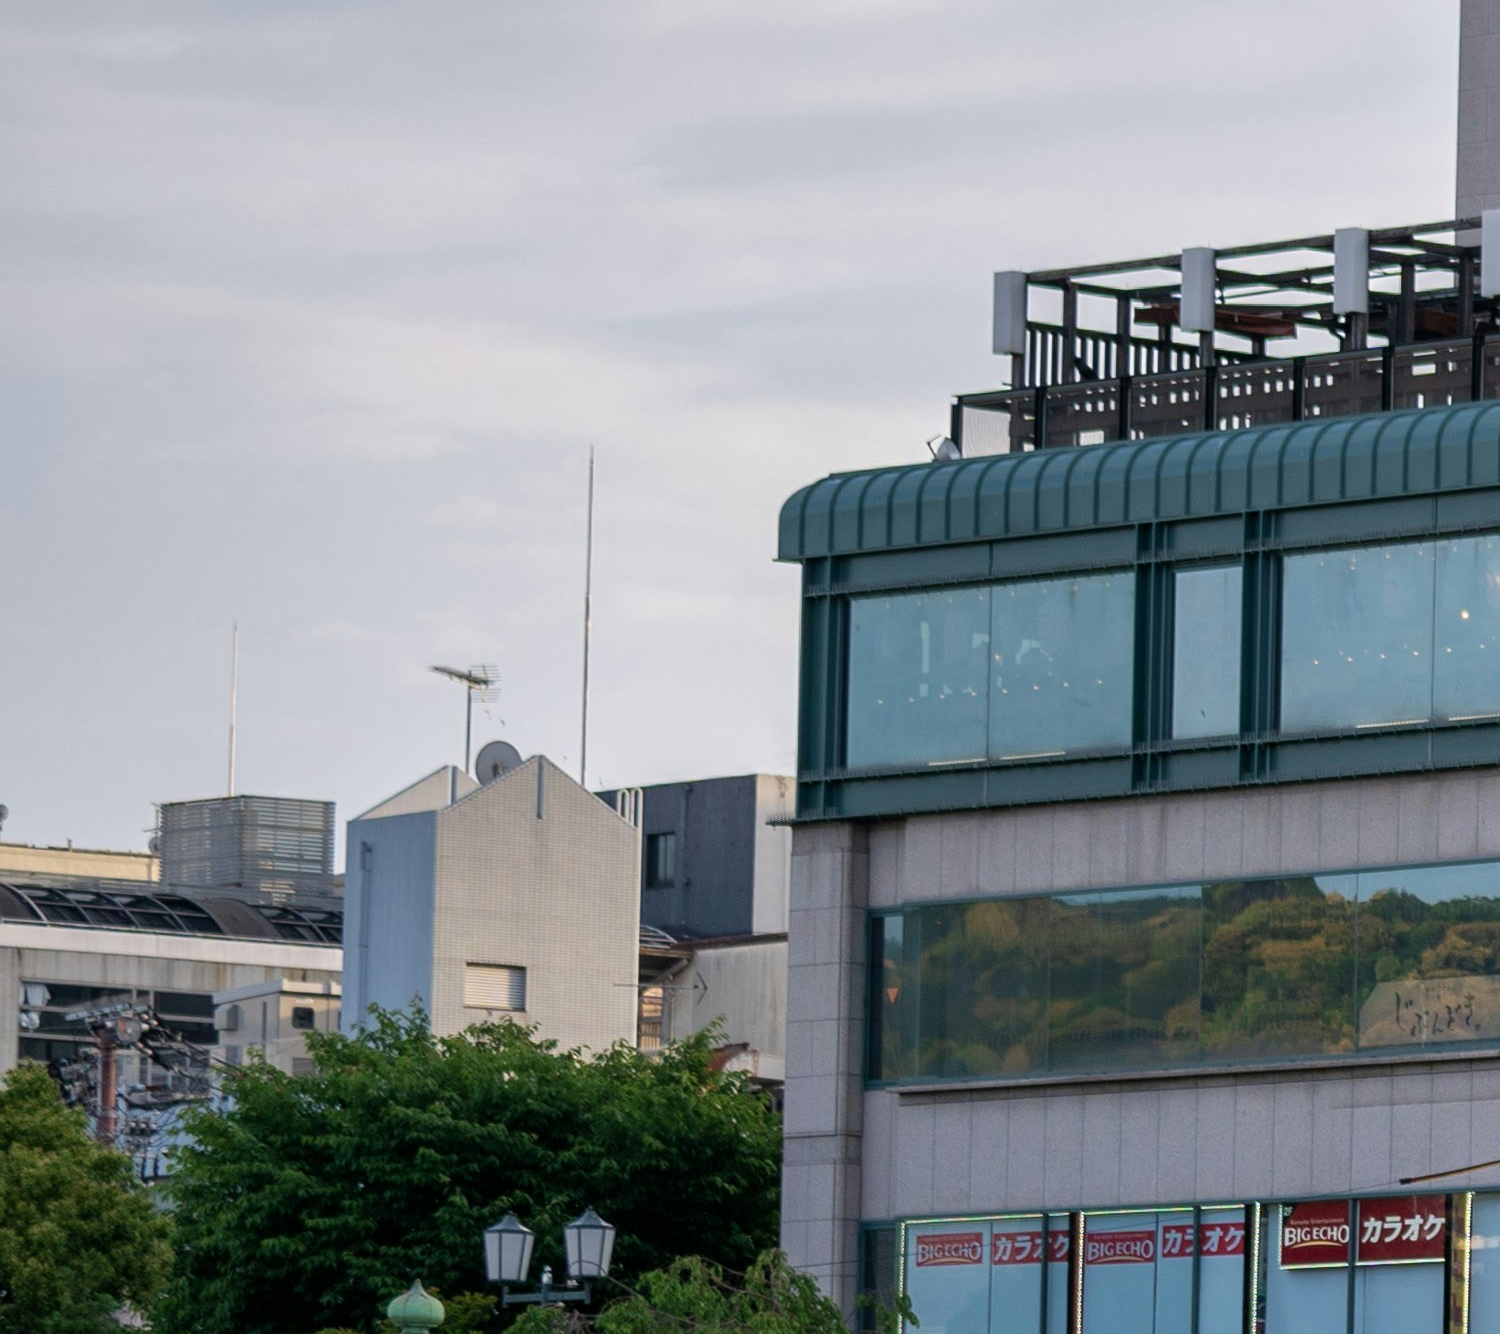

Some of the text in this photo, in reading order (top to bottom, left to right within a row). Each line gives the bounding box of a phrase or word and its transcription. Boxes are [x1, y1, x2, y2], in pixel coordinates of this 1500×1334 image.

[1284, 1225, 1350, 1247] BIG ECHO
[1362, 1214, 1445, 1244] カラオケ
[918, 1241, 982, 1264] BIG ECHO
[1087, 1239, 1154, 1262] BIG ECHO
